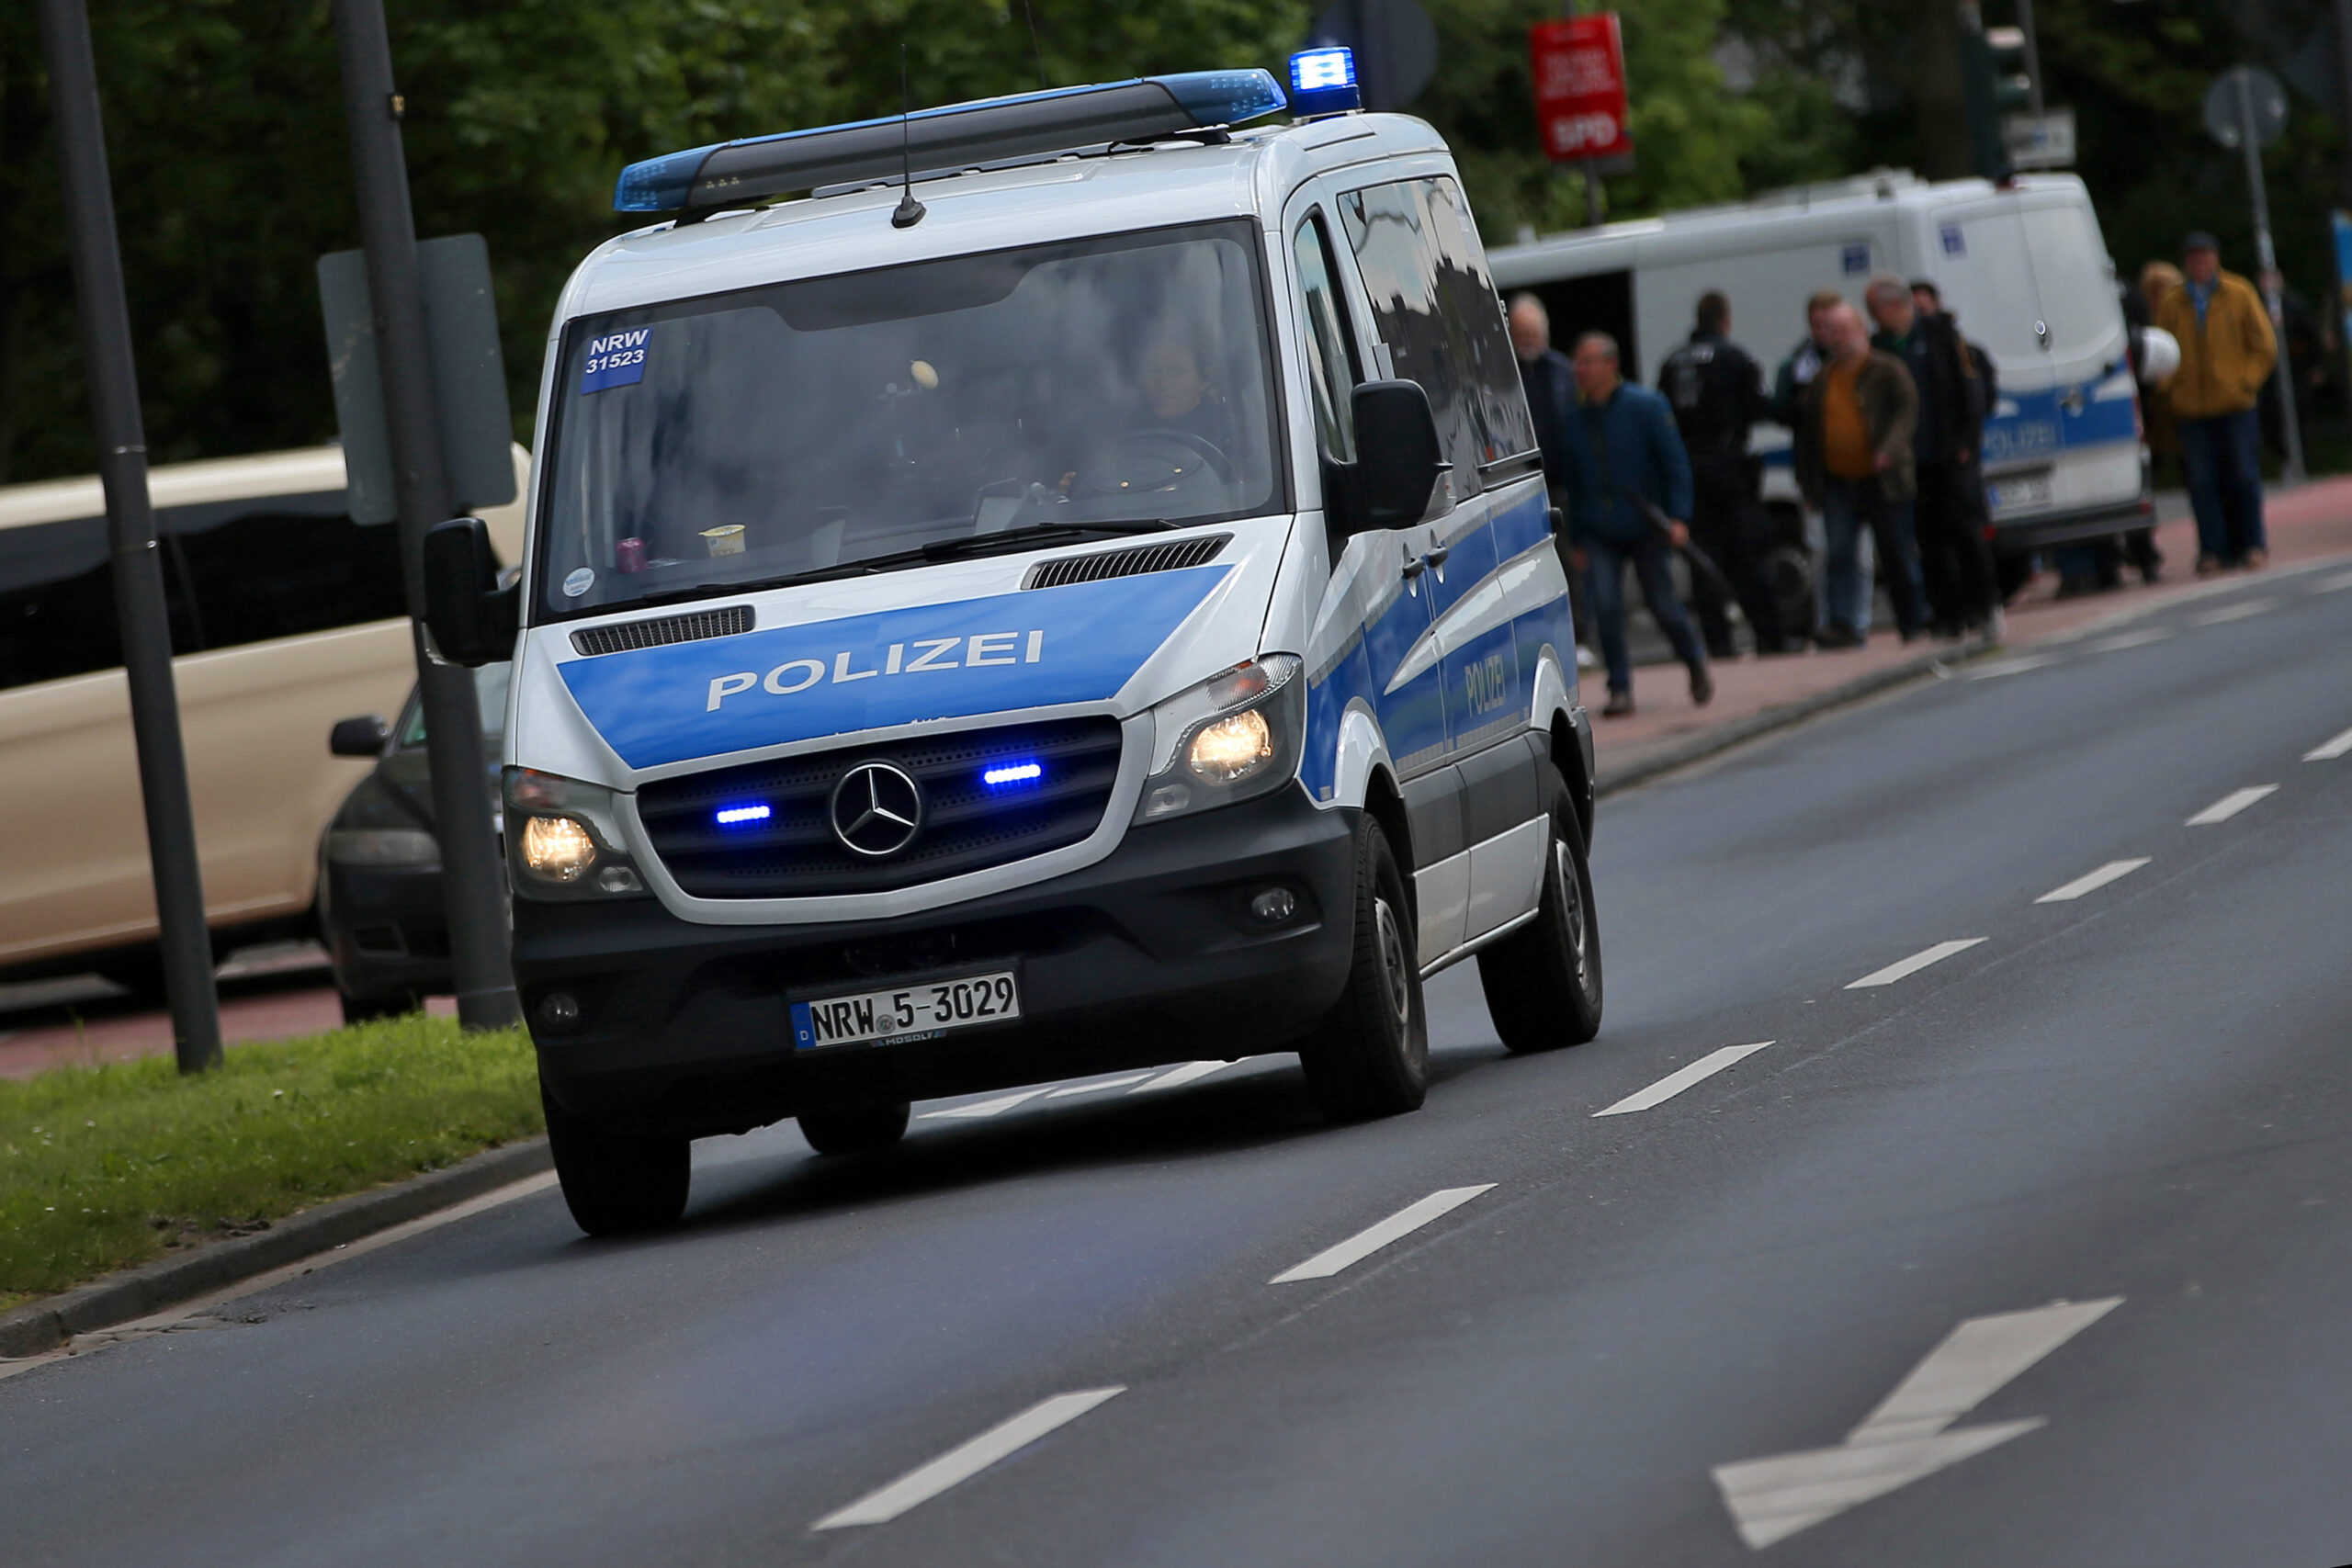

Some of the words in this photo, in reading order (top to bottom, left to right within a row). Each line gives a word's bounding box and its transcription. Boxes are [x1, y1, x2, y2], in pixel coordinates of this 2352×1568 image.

[1551, 112, 1618, 153] SPD
[590, 329, 649, 356] NRW
[586, 349, 645, 374] 31523
[706, 629, 1044, 713] POLIZEI
[810, 998, 876, 1042] NRW
[892, 976, 1015, 1029] 5-3029
[798, 1030, 809, 1042] D
[886, 1031, 933, 1045] MOSOLF
